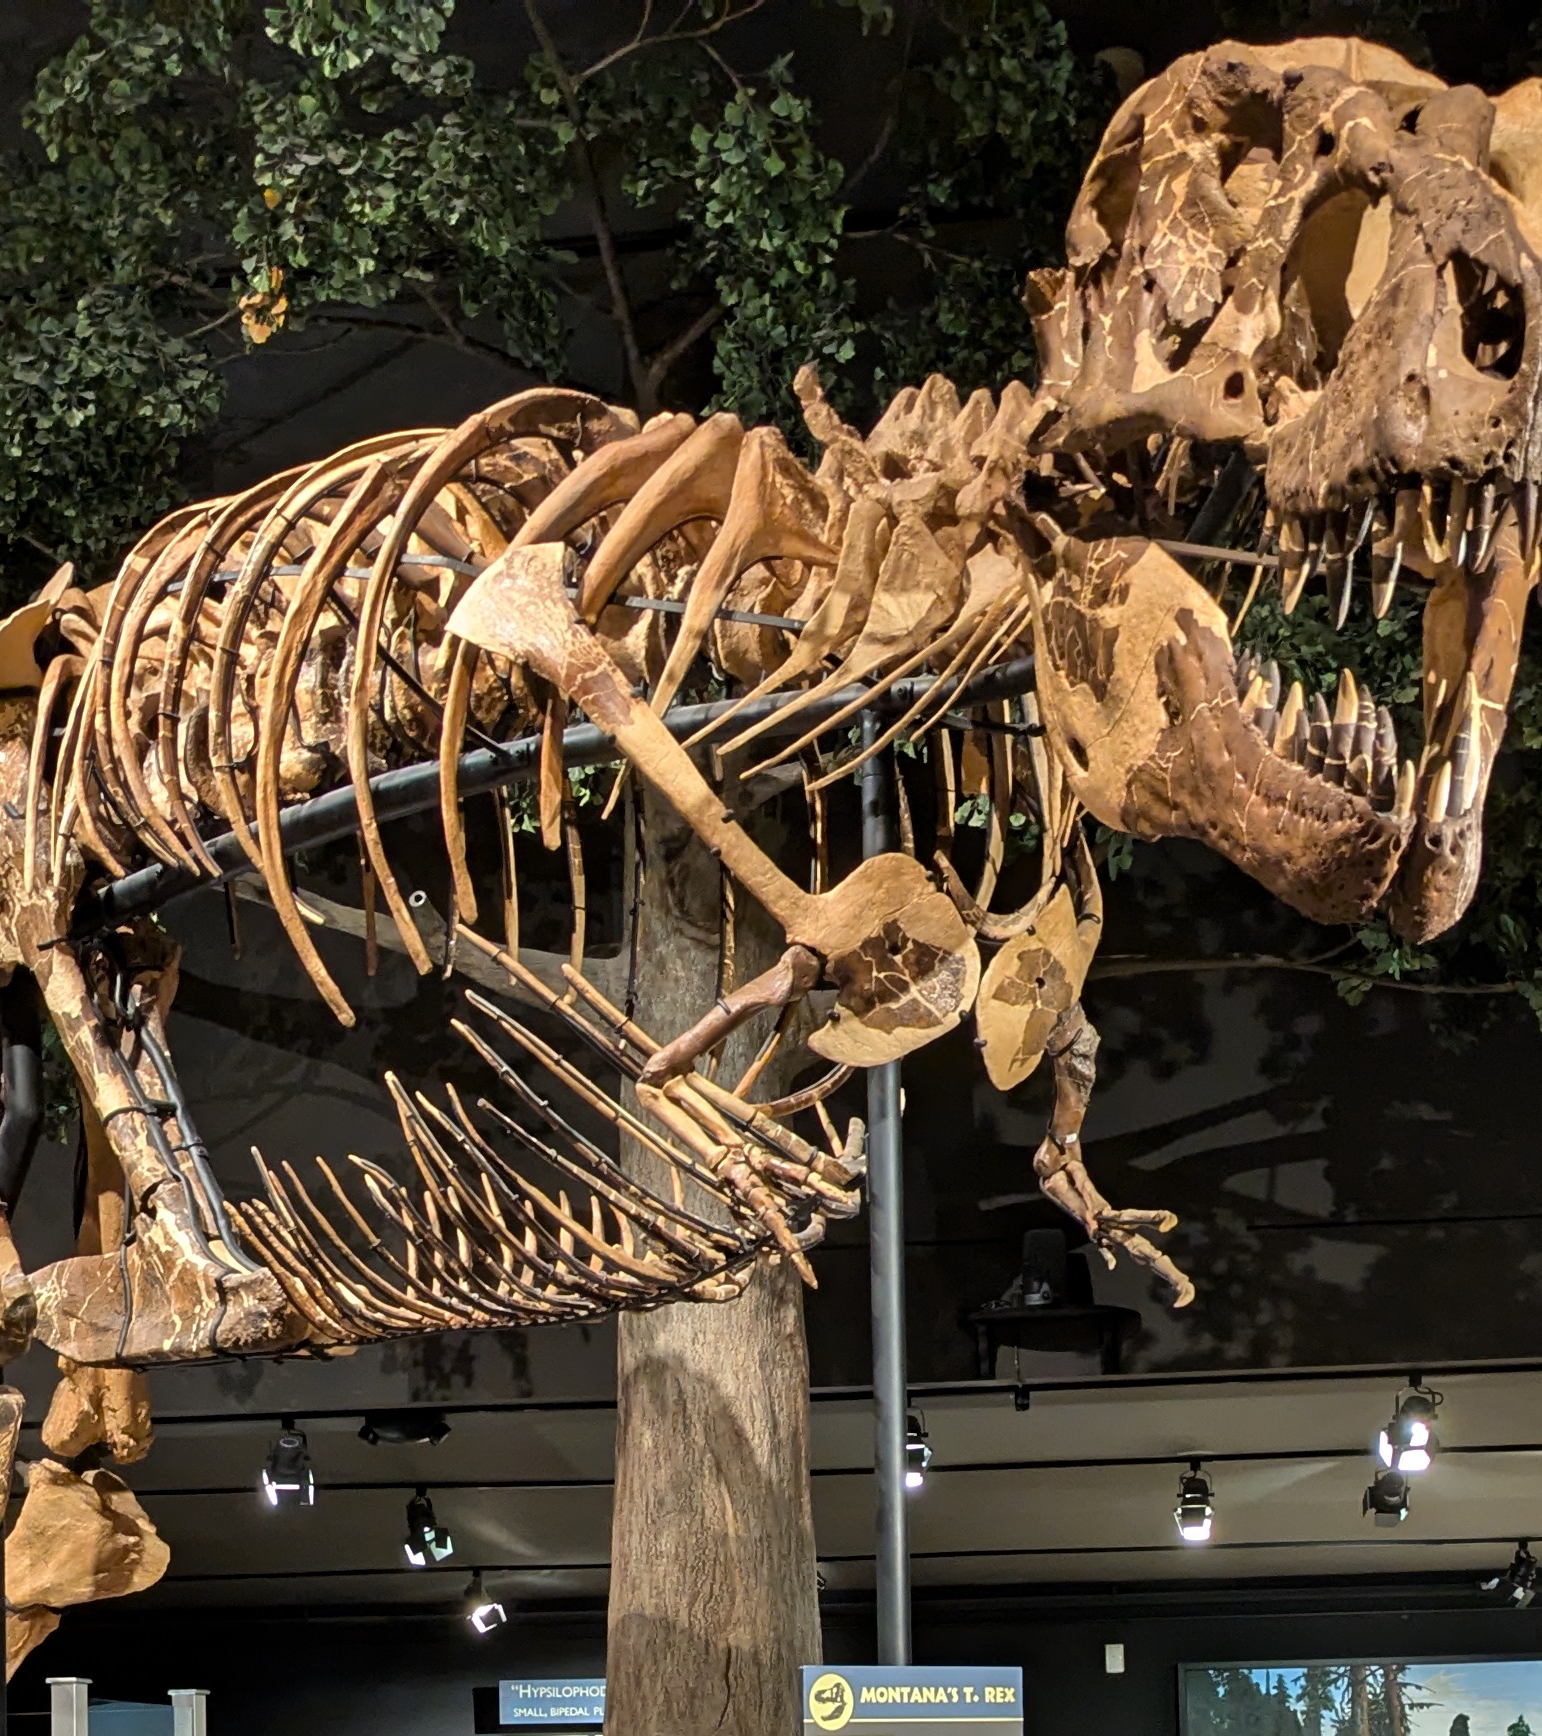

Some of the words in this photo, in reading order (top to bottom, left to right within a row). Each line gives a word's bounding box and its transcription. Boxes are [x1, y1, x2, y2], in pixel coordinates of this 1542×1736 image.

[860, 1686, 959, 1704] MONTANA'S
[963, 1686, 980, 1703] T.
[984, 1687, 1016, 1703] REX
[513, 1707, 548, 1718] SMALL,
[550, 1706, 590, 1717] BIPEDAL
